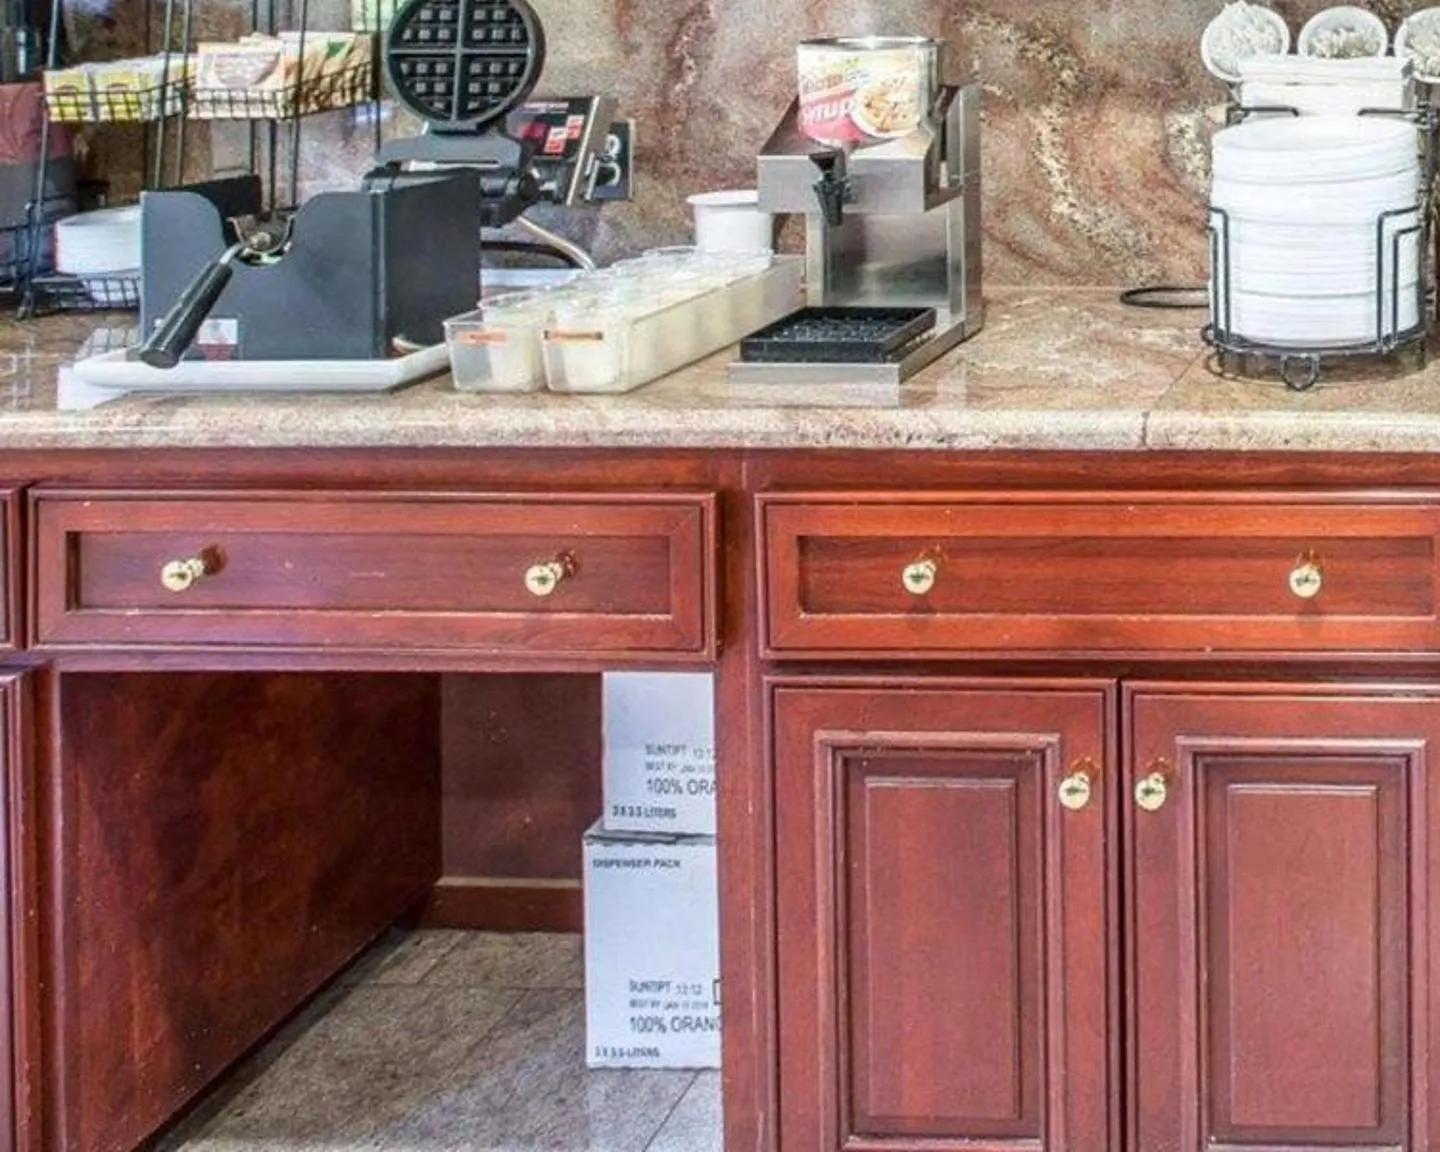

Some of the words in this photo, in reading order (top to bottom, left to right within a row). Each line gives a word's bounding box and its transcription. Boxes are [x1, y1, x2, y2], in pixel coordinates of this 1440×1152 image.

[646, 777, 684, 795] 100%
[644, 807, 677, 819] LITERS
[592, 858, 652, 869] DISPENSER
[653, 858, 681, 868] PACK
[629, 1015, 667, 1034] 100%
